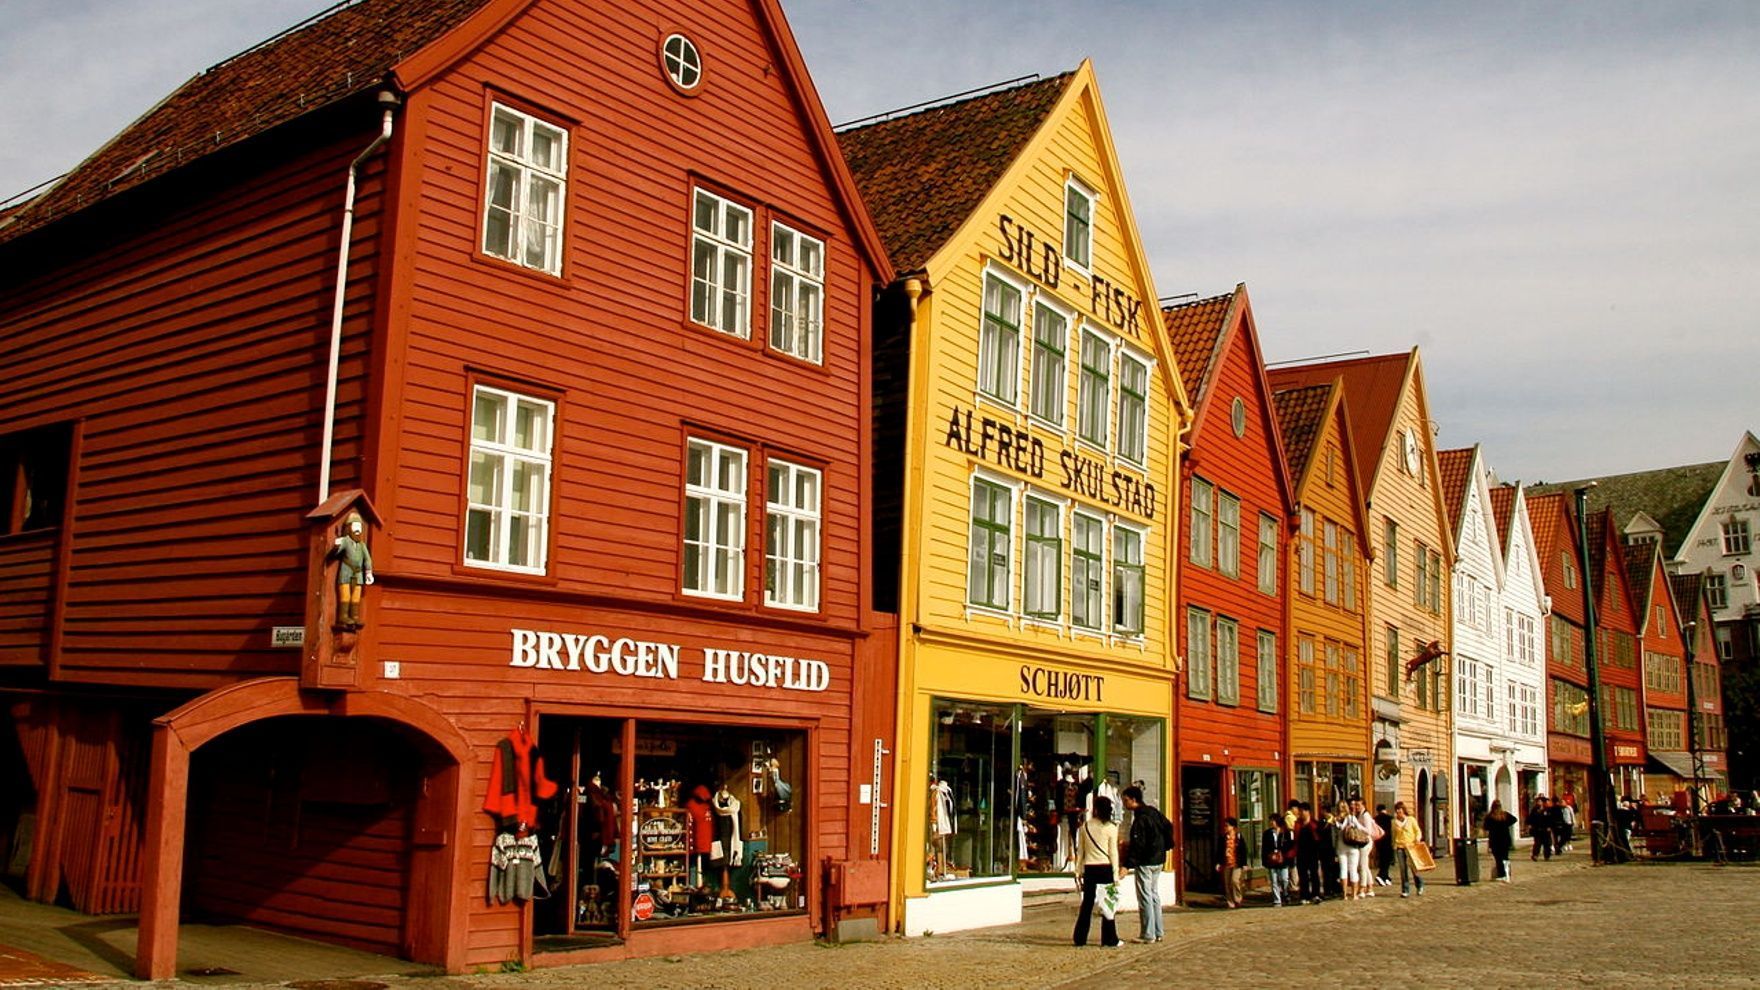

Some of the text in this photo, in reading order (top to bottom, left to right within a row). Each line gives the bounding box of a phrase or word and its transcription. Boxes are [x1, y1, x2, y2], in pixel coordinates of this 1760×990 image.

[997, 214, 1060, 290] SILD
[1091, 275, 1143, 339] FISK
[945, 405, 1155, 519] ALFRED SKULSTAD
[510, 628, 831, 692] BRYGGEN HUSFLID
[1019, 664, 1105, 703] SCHJØTT
